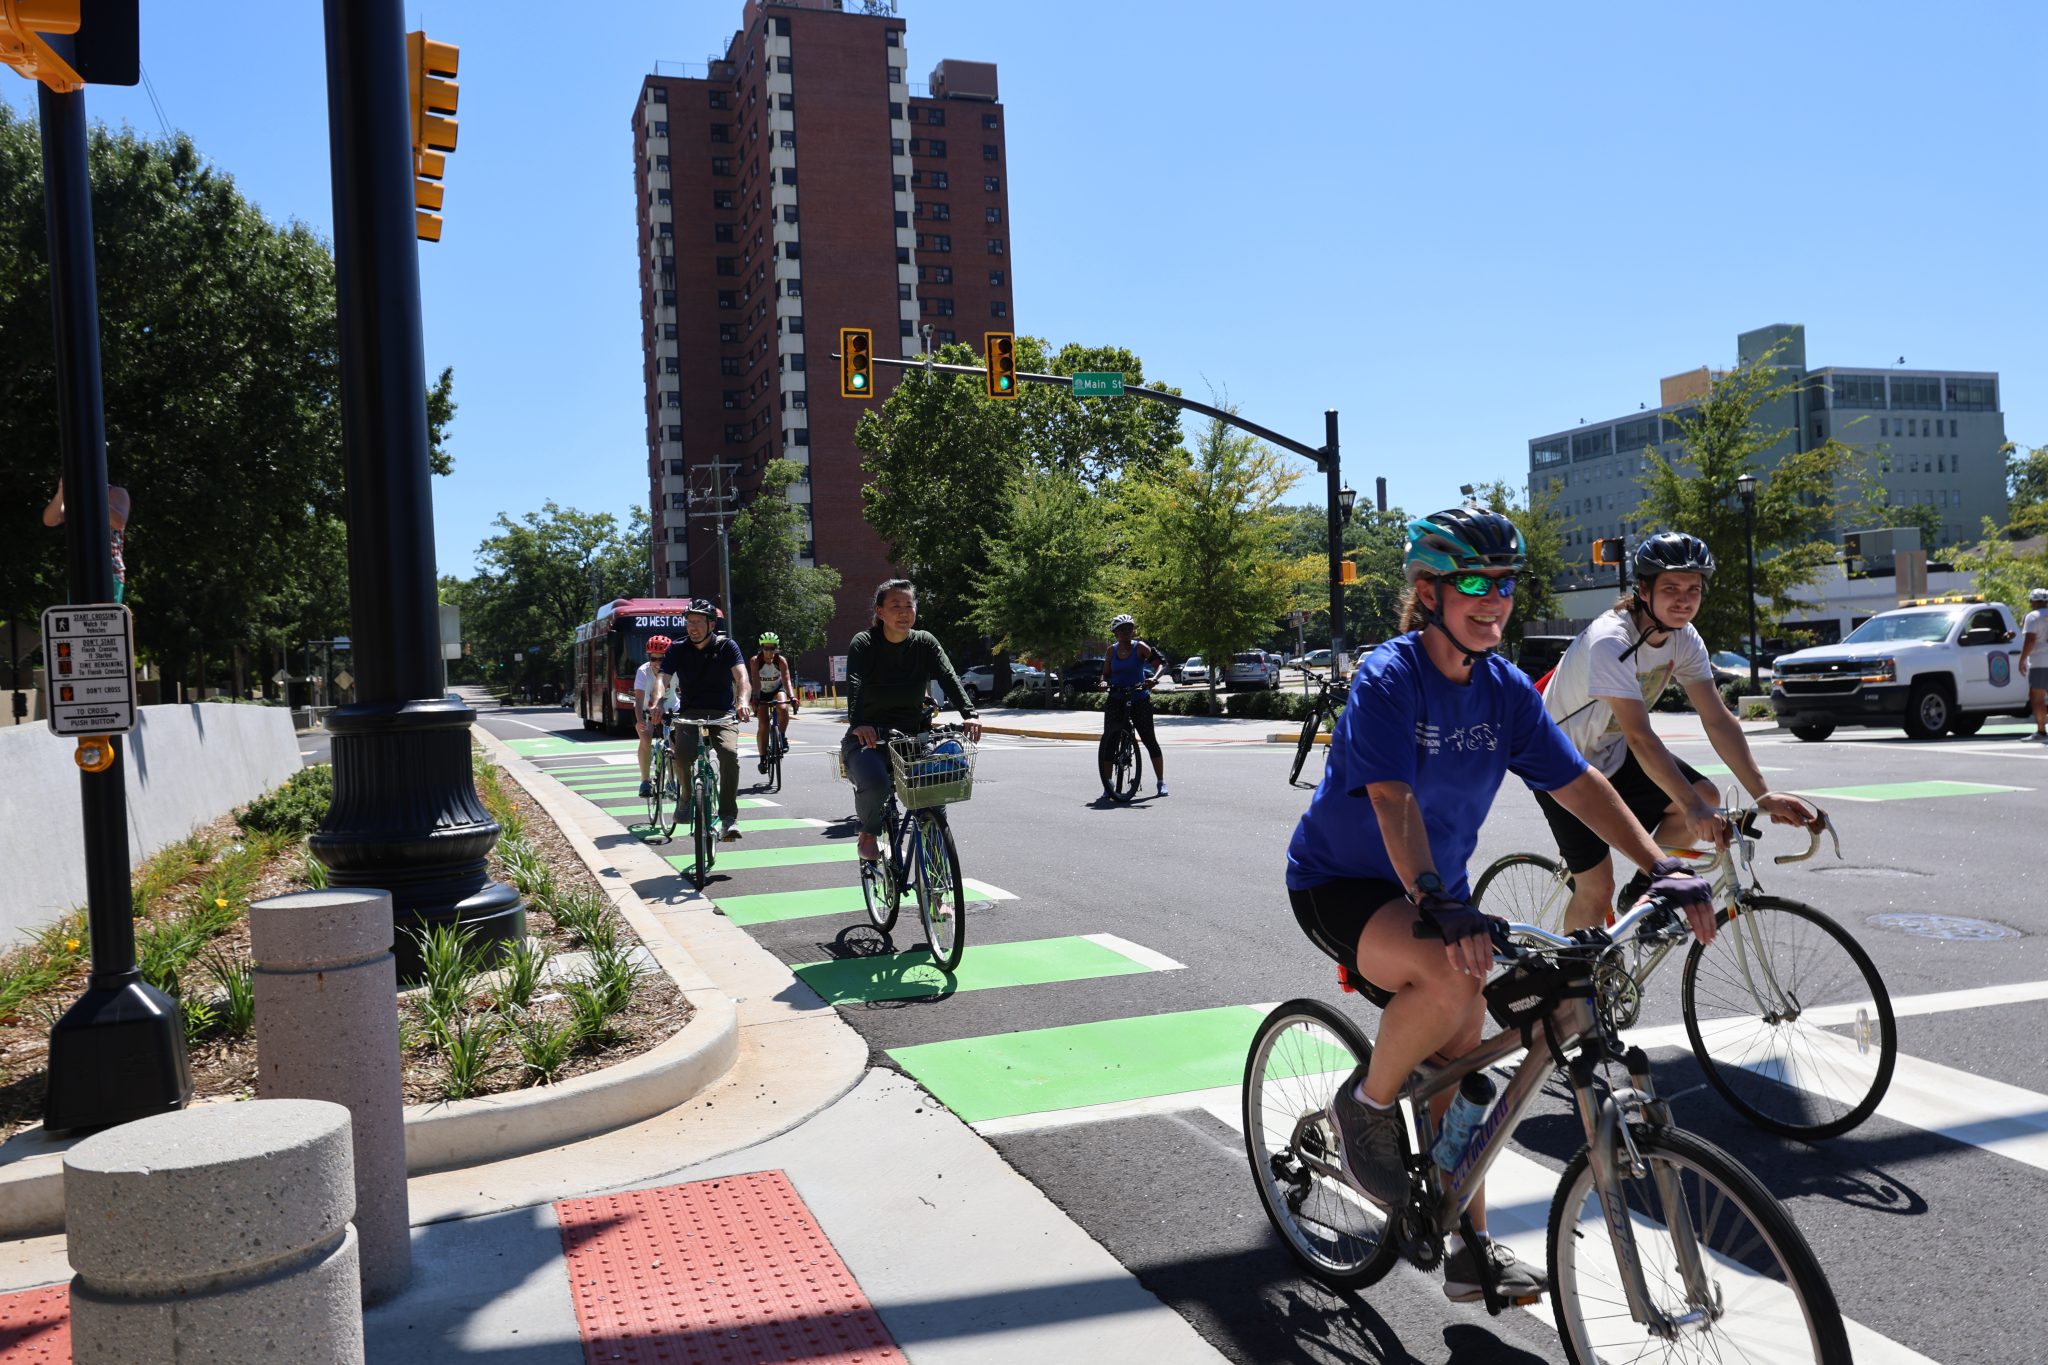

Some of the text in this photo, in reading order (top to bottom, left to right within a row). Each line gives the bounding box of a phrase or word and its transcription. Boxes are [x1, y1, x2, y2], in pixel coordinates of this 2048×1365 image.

[1084, 379, 1122, 389] Main St
[73, 612, 118, 621] START CROSSING
[635, 616, 648, 627] 20
[649, 616, 670, 627] WEST
[101, 638, 116, 646] START
[104, 668, 125, 676] Crossing
